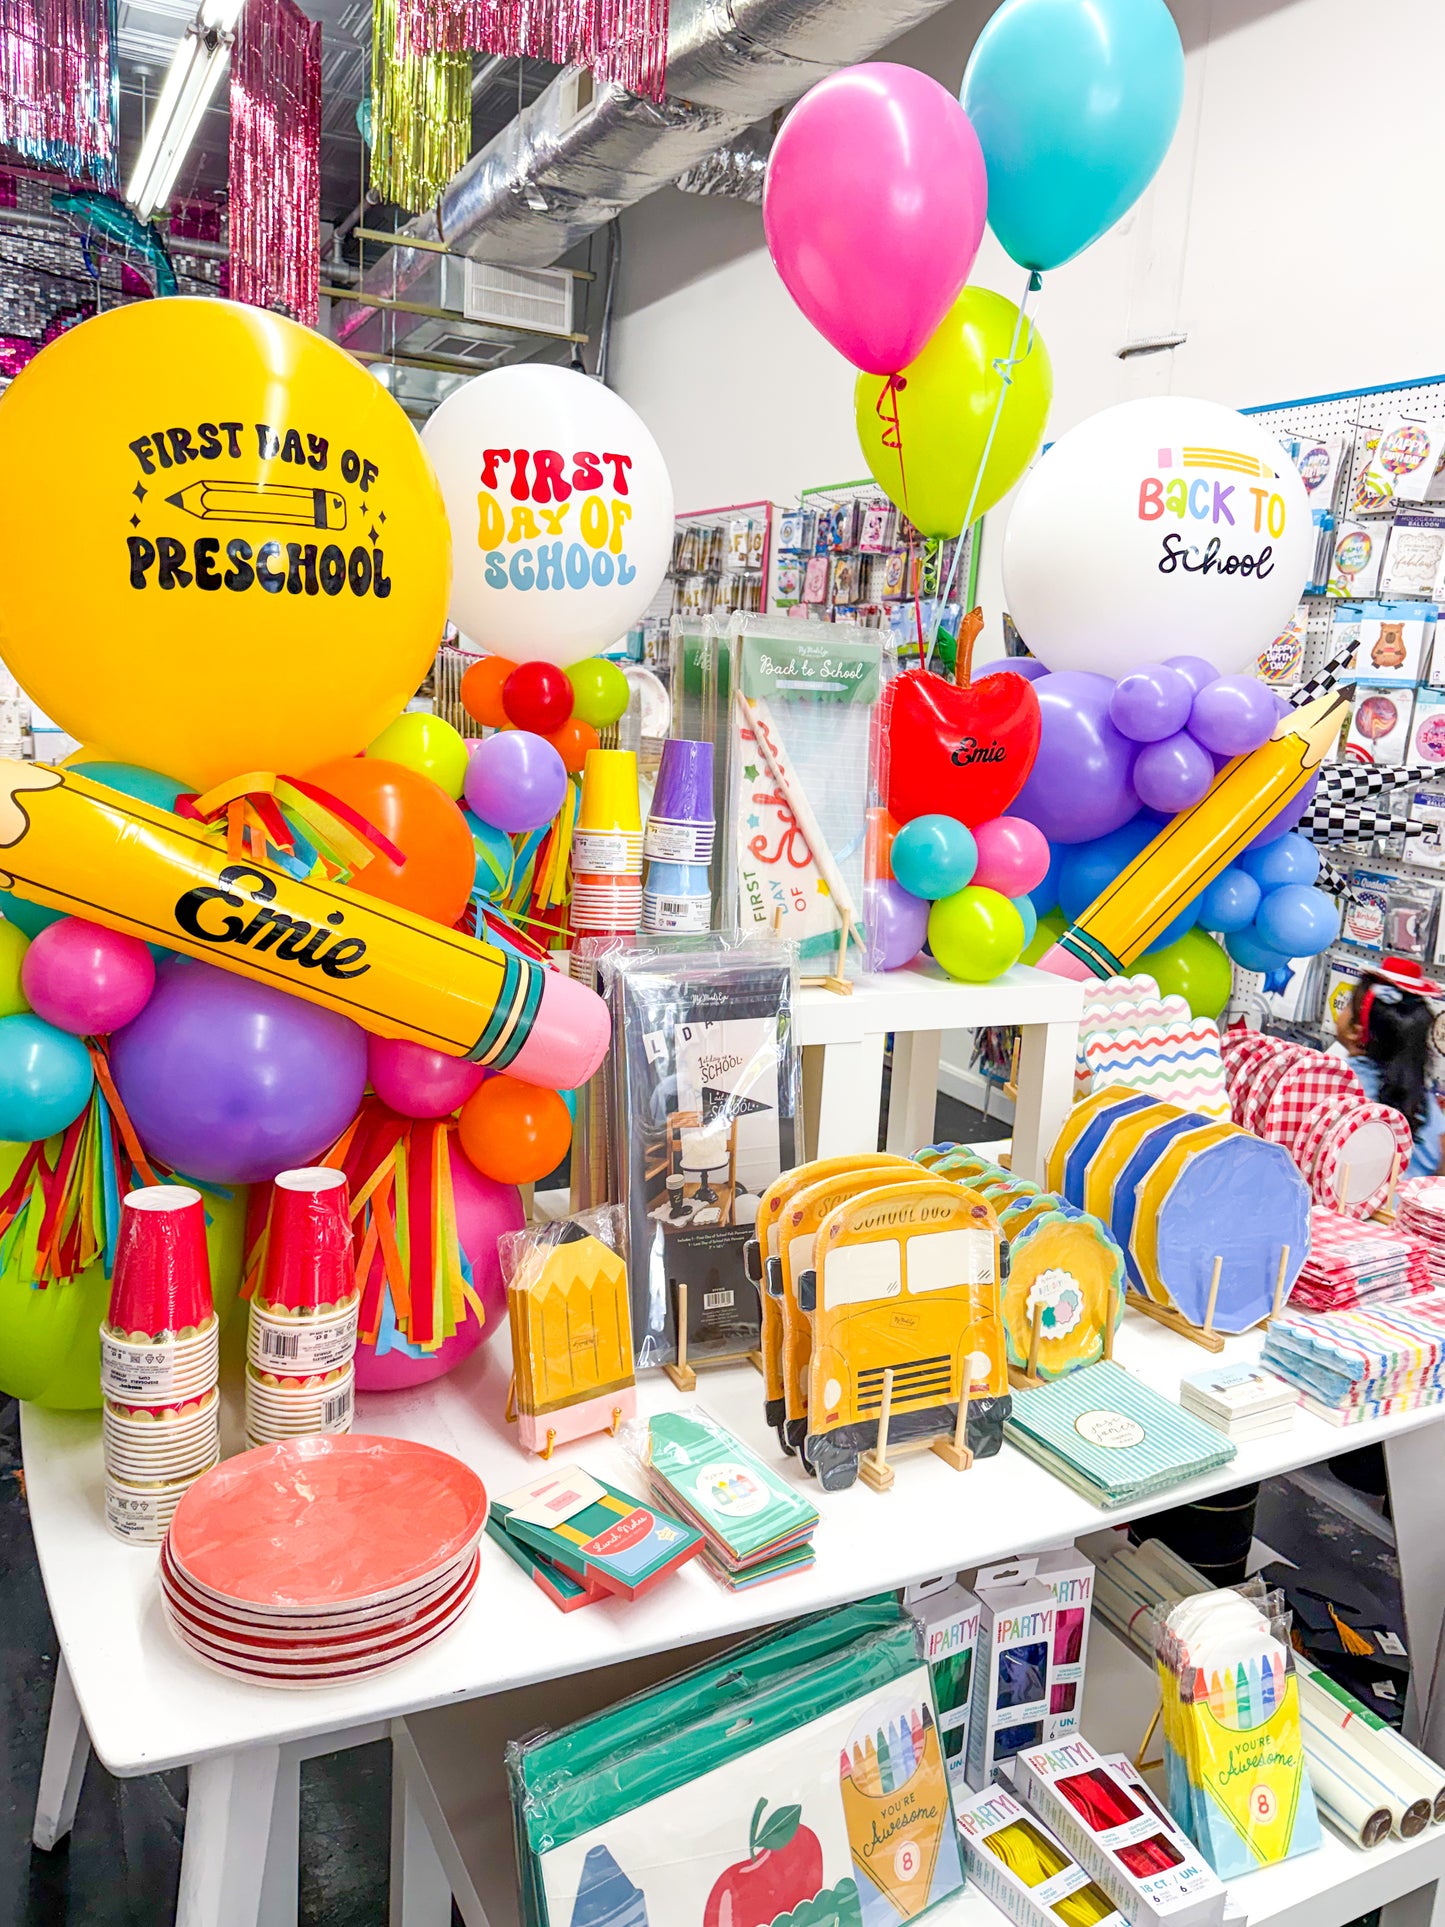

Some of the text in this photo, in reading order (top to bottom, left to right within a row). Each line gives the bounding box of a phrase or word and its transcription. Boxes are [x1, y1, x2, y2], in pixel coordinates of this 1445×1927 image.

[129, 422, 379, 492] FIRST DAY OF
[1382, 450, 1423, 466] BIRTHDAY
[1386, 436, 1426, 455] HAPPY
[480, 448, 633, 503] FIRST
[477, 491, 633, 554] DAY OF
[1249, 487, 1286, 539] TO
[126, 536, 392, 599] PRESCHOOL
[484, 542, 636, 590] SCHOOL
[1158, 533, 1275, 580] School
[760, 654, 864, 680] Back to School
[1270, 661, 1286, 671] DAY
[951, 737, 1007, 767] Emie
[743, 871, 767, 922] FIRST
[790, 887, 807, 912] OF
[174, 865, 371, 979] Emie
[701, 1056, 741, 1084] SCHOOL
[592, 1533, 621, 1553] Lunch
[616, 1516, 648, 1533] Notes
[1052, 1577, 1091, 1603] ARTY!
[932, 1615, 979, 1653] PARTY!
[1001, 1610, 1053, 1642] PARTY!
[1032, 1741, 1095, 1774] PARTY!
[1235, 1735, 1271, 1754] YOU'RE
[1219, 1750, 1296, 1785] Awesome
[881, 1792, 916, 1819] YOU'RE
[960, 1794, 1020, 1833] PARTY!
[1257, 1794, 1270, 1814] 8
[863, 1806, 938, 1858] Awesome
[902, 1852, 913, 1871] 8
